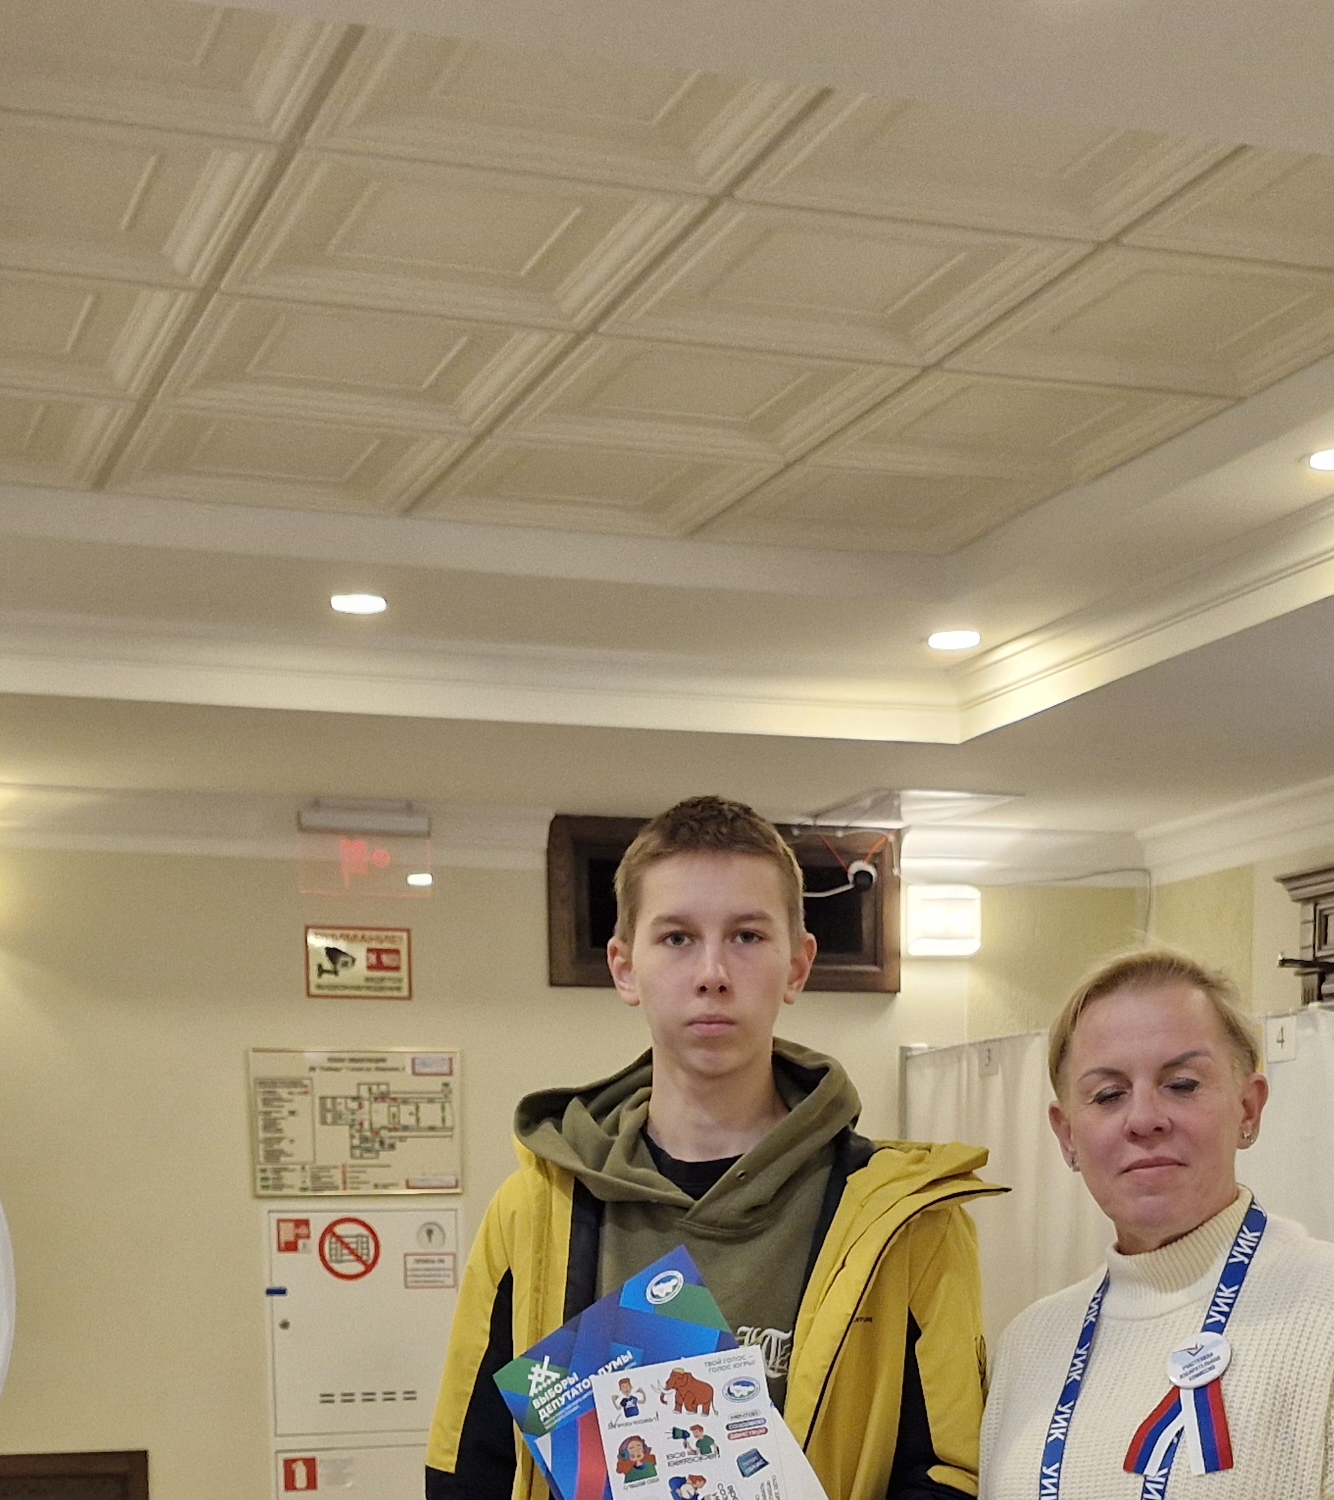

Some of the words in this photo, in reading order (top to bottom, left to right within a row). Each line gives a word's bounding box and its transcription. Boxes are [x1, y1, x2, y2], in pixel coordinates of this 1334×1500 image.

[1276, 1025, 1285, 1048] 4
[1228, 1224, 1262, 1264] УИК
[1205, 1282, 1240, 1324] УИК
[1066, 1342, 1090, 1386] УИК
[532, 1372, 579, 1410] ВЫБОРЫ
[538, 1375, 595, 1422] ДЕПУТАТО
[1047, 1400, 1074, 1443] УИК
